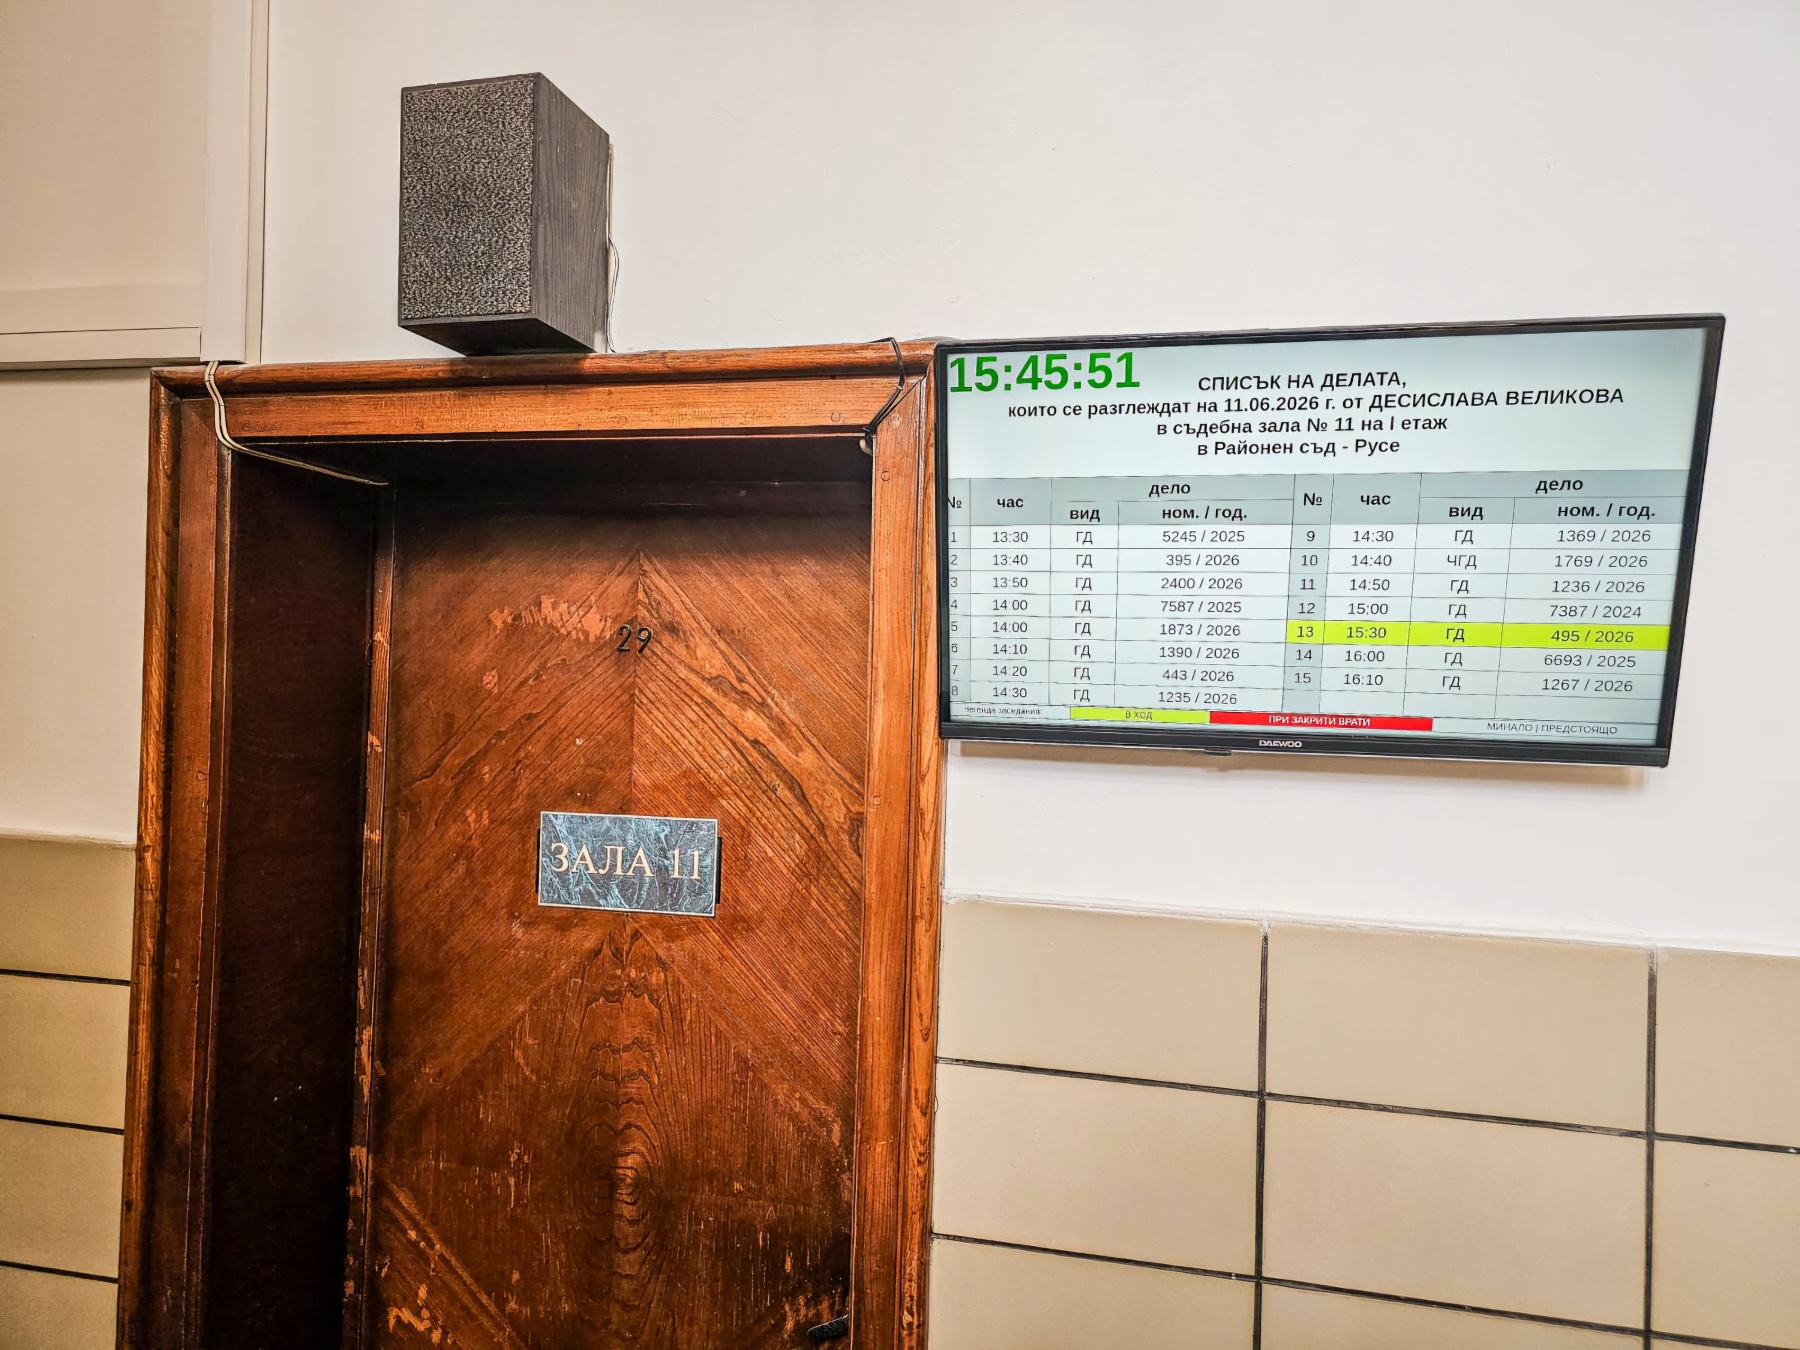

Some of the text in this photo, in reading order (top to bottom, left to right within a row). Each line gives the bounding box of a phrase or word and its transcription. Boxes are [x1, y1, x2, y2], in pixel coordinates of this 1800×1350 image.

[950, 352, 1140, 392] 15:45:51
[1198, 371, 1407, 392] СПИСЪК НА ДЕЛАТА,
[1008, 388, 1624, 420] които се разглеждат на 11.06.2026 г. от ДЕСИСЛАВА ВЕЛИКОВА
[1157, 424, 1168, 436] в
[1172, 419, 1253, 439] съдебна
[1258, 420, 1302, 433] зала
[1307, 417, 1328, 433] №
[1334, 416, 1355, 432] 11
[1361, 419, 1384, 431] на
[1401, 417, 1448, 431] етаж
[1197, 444, 1208, 456] в
[1214, 439, 1294, 456] Районен
[1299, 442, 1336, 458] съд
[1355, 438, 1400, 457] Русе
[1148, 483, 1191, 498] дело
[1535, 479, 1584, 495] дело
[996, 498, 1024, 508] час
[1303, 492, 1392, 506] № час
[1069, 505, 1247, 523] вид ном. / год.
[1448, 502, 1656, 521] вид ном. / год.
[950, 529, 1245, 545] 1 13:30 ГД 5245 / 2025
[1306, 528, 1651, 545] 9 14:30 ГД 1369 / 2026
[950, 553, 1240, 569] 2 13:40 ГД 395 / 2026
[1301, 554, 1648, 570] 10 14:40 ЧГД 1769 / 2026
[950, 576, 1243, 592] 3 13:50 ГД 2400 / 2026
[1300, 578, 1645, 595] 11 14:50 ГД 1236 / 2026
[950, 599, 1242, 614] 4 14:00 ГД 7587 / 2025
[1297, 602, 1642, 619] 12 15:00 ГД 7387 / 2024
[950, 620, 1241, 637] 5 14:00 ГД 1873 / 2026
[1296, 625, 1634, 643] 13 15:30 ГД 495 / 2026
[618, 624, 652, 654] 29
[951, 643, 1240, 660] 6 14:10 ГД 1390 / 2026
[1296, 649, 1636, 668] 14 16:00 ГД 6693 / 2025
[951, 664, 1235, 682] 7 14:20 ГД 443 / 2026
[1294, 672, 1633, 692] 15 16:10 ГД 1267 / 2026
[951, 685, 1237, 705] 8 14:30 ГД 1235 / 2026
[1125, 710, 1131, 719] В
[1269, 715, 1371, 727] ПРИ ЗАКРИТИ ВРАТИ
[1487, 722, 1533, 732] МИНАЛО
[1541, 724, 1618, 735] ПРЕДСТОЯЩО
[1259, 739, 1302, 748] DAEWOO
[551, 842, 701, 880] ЗАЛА 11
